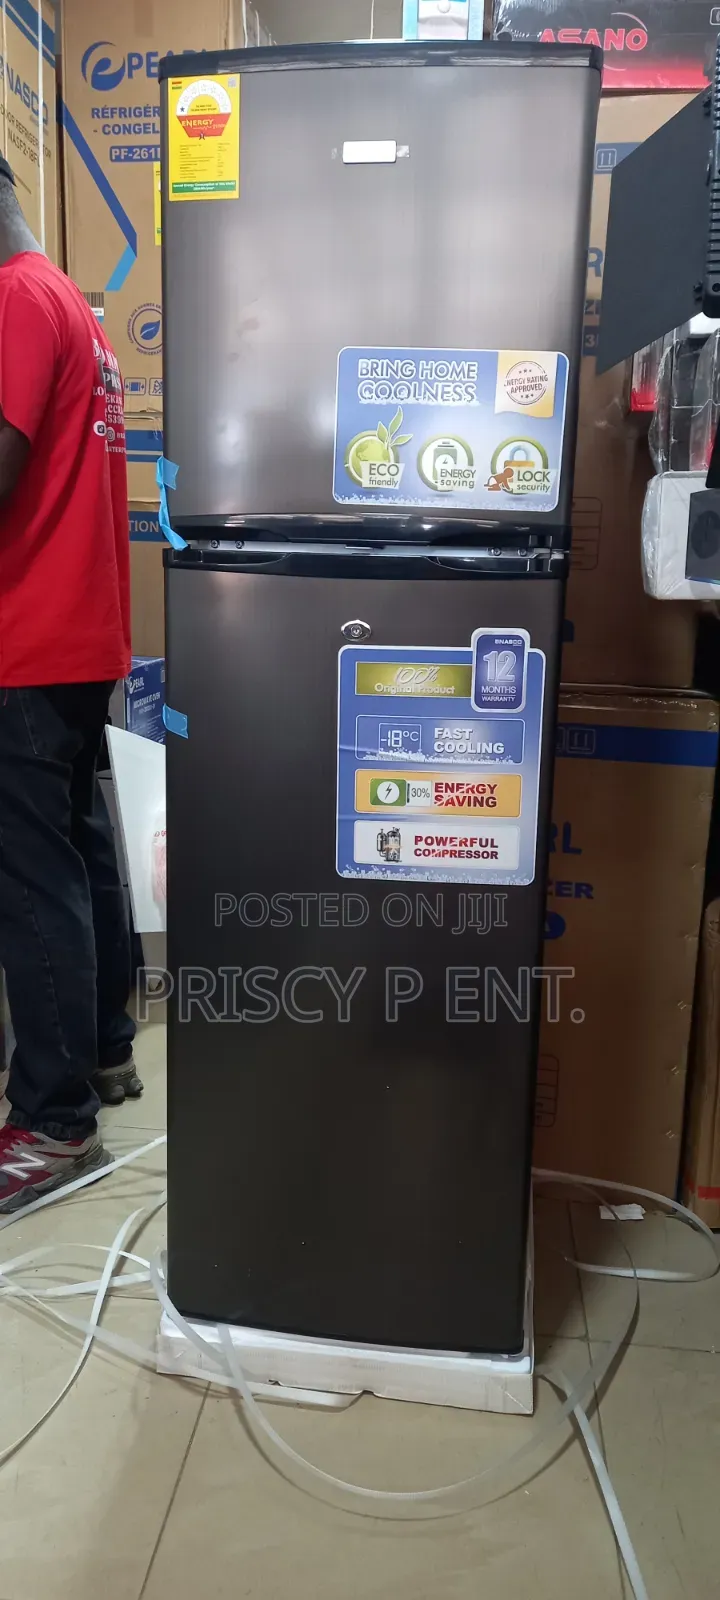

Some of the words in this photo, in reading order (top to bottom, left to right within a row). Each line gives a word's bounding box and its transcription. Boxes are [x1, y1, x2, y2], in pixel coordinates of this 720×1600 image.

[358, 359, 415, 378] BRING
[420, 361, 478, 380] HOME
[358, 381, 477, 402] COOLNESS
[510, 383, 542, 394] APPROVED
[369, 464, 399, 476] ECO
[440, 469, 476, 478] ENERGY
[517, 471, 550, 482] LOCK
[368, 478, 398, 488] friendly
[440, 478, 474, 488] saving
[516, 483, 550, 492] security
[483, 651, 516, 682] 12
[394, 666, 440, 684] 100%
[374, 683, 414, 694] Original
[417, 684, 456, 694] Product
[482, 686, 516, 694] MONTHS
[434, 728, 473, 740] FAST
[434, 742, 504, 754] COOLING
[411, 787, 430, 798] 30%
[434, 782, 498, 794] ENERGY
[434, 795, 497, 808] SAVING
[414, 835, 498, 848] POWERFUL
[414, 848, 498, 860] COMPRESSOR
